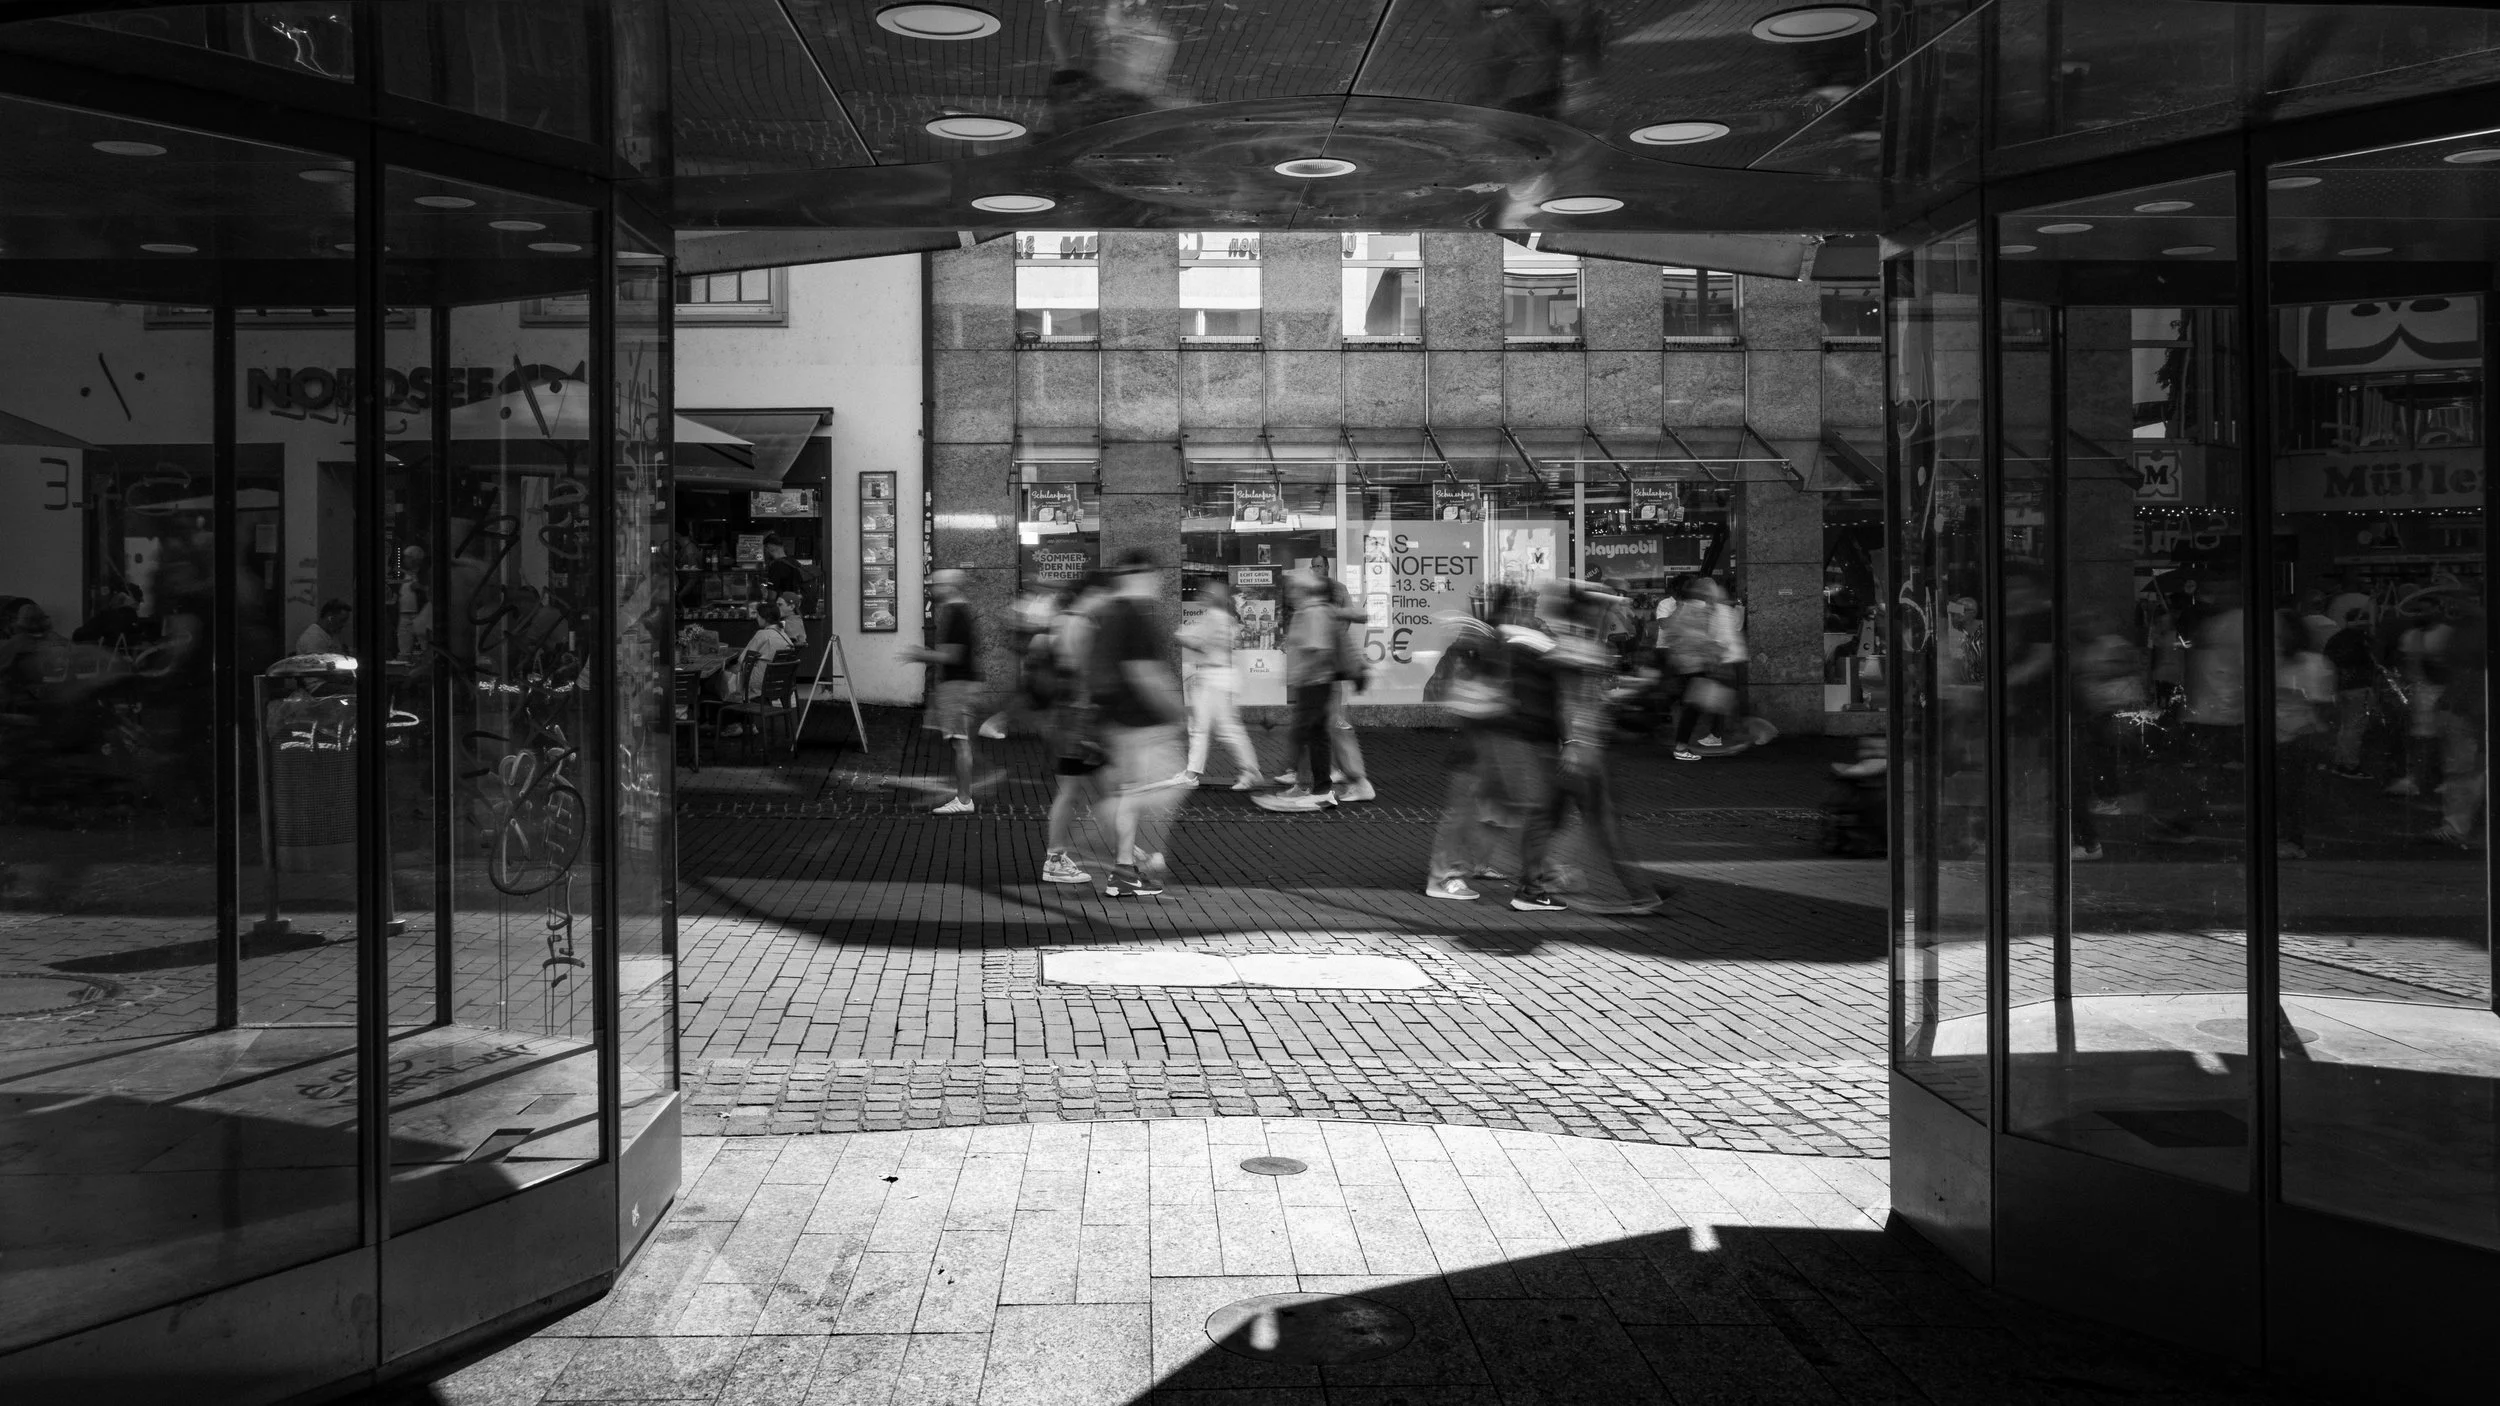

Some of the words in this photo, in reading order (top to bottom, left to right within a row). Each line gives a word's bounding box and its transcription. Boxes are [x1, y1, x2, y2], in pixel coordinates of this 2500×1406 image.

[2145, 465, 2168, 485] M
[2323, 463, 2484, 499] Mülle
[1031, 489, 1072, 502] Schulanfang
[1236, 489, 1276, 502] Schulanfang
[1436, 488, 1475, 501] Schuanfang
[1634, 487, 1673, 500] Schulanfang
[1584, 539, 1658, 559] playmobil
[1044, 563, 1064, 571] DER
[1065, 563, 1082, 571] NIE
[1363, 556, 1479, 576] NOFEST
[1040, 571, 1084, 580] VERGEHT
[1391, 595, 1431, 608] Filme.
[1391, 611, 1433, 625] Kinos.
[1363, 627, 1414, 664] 5€
